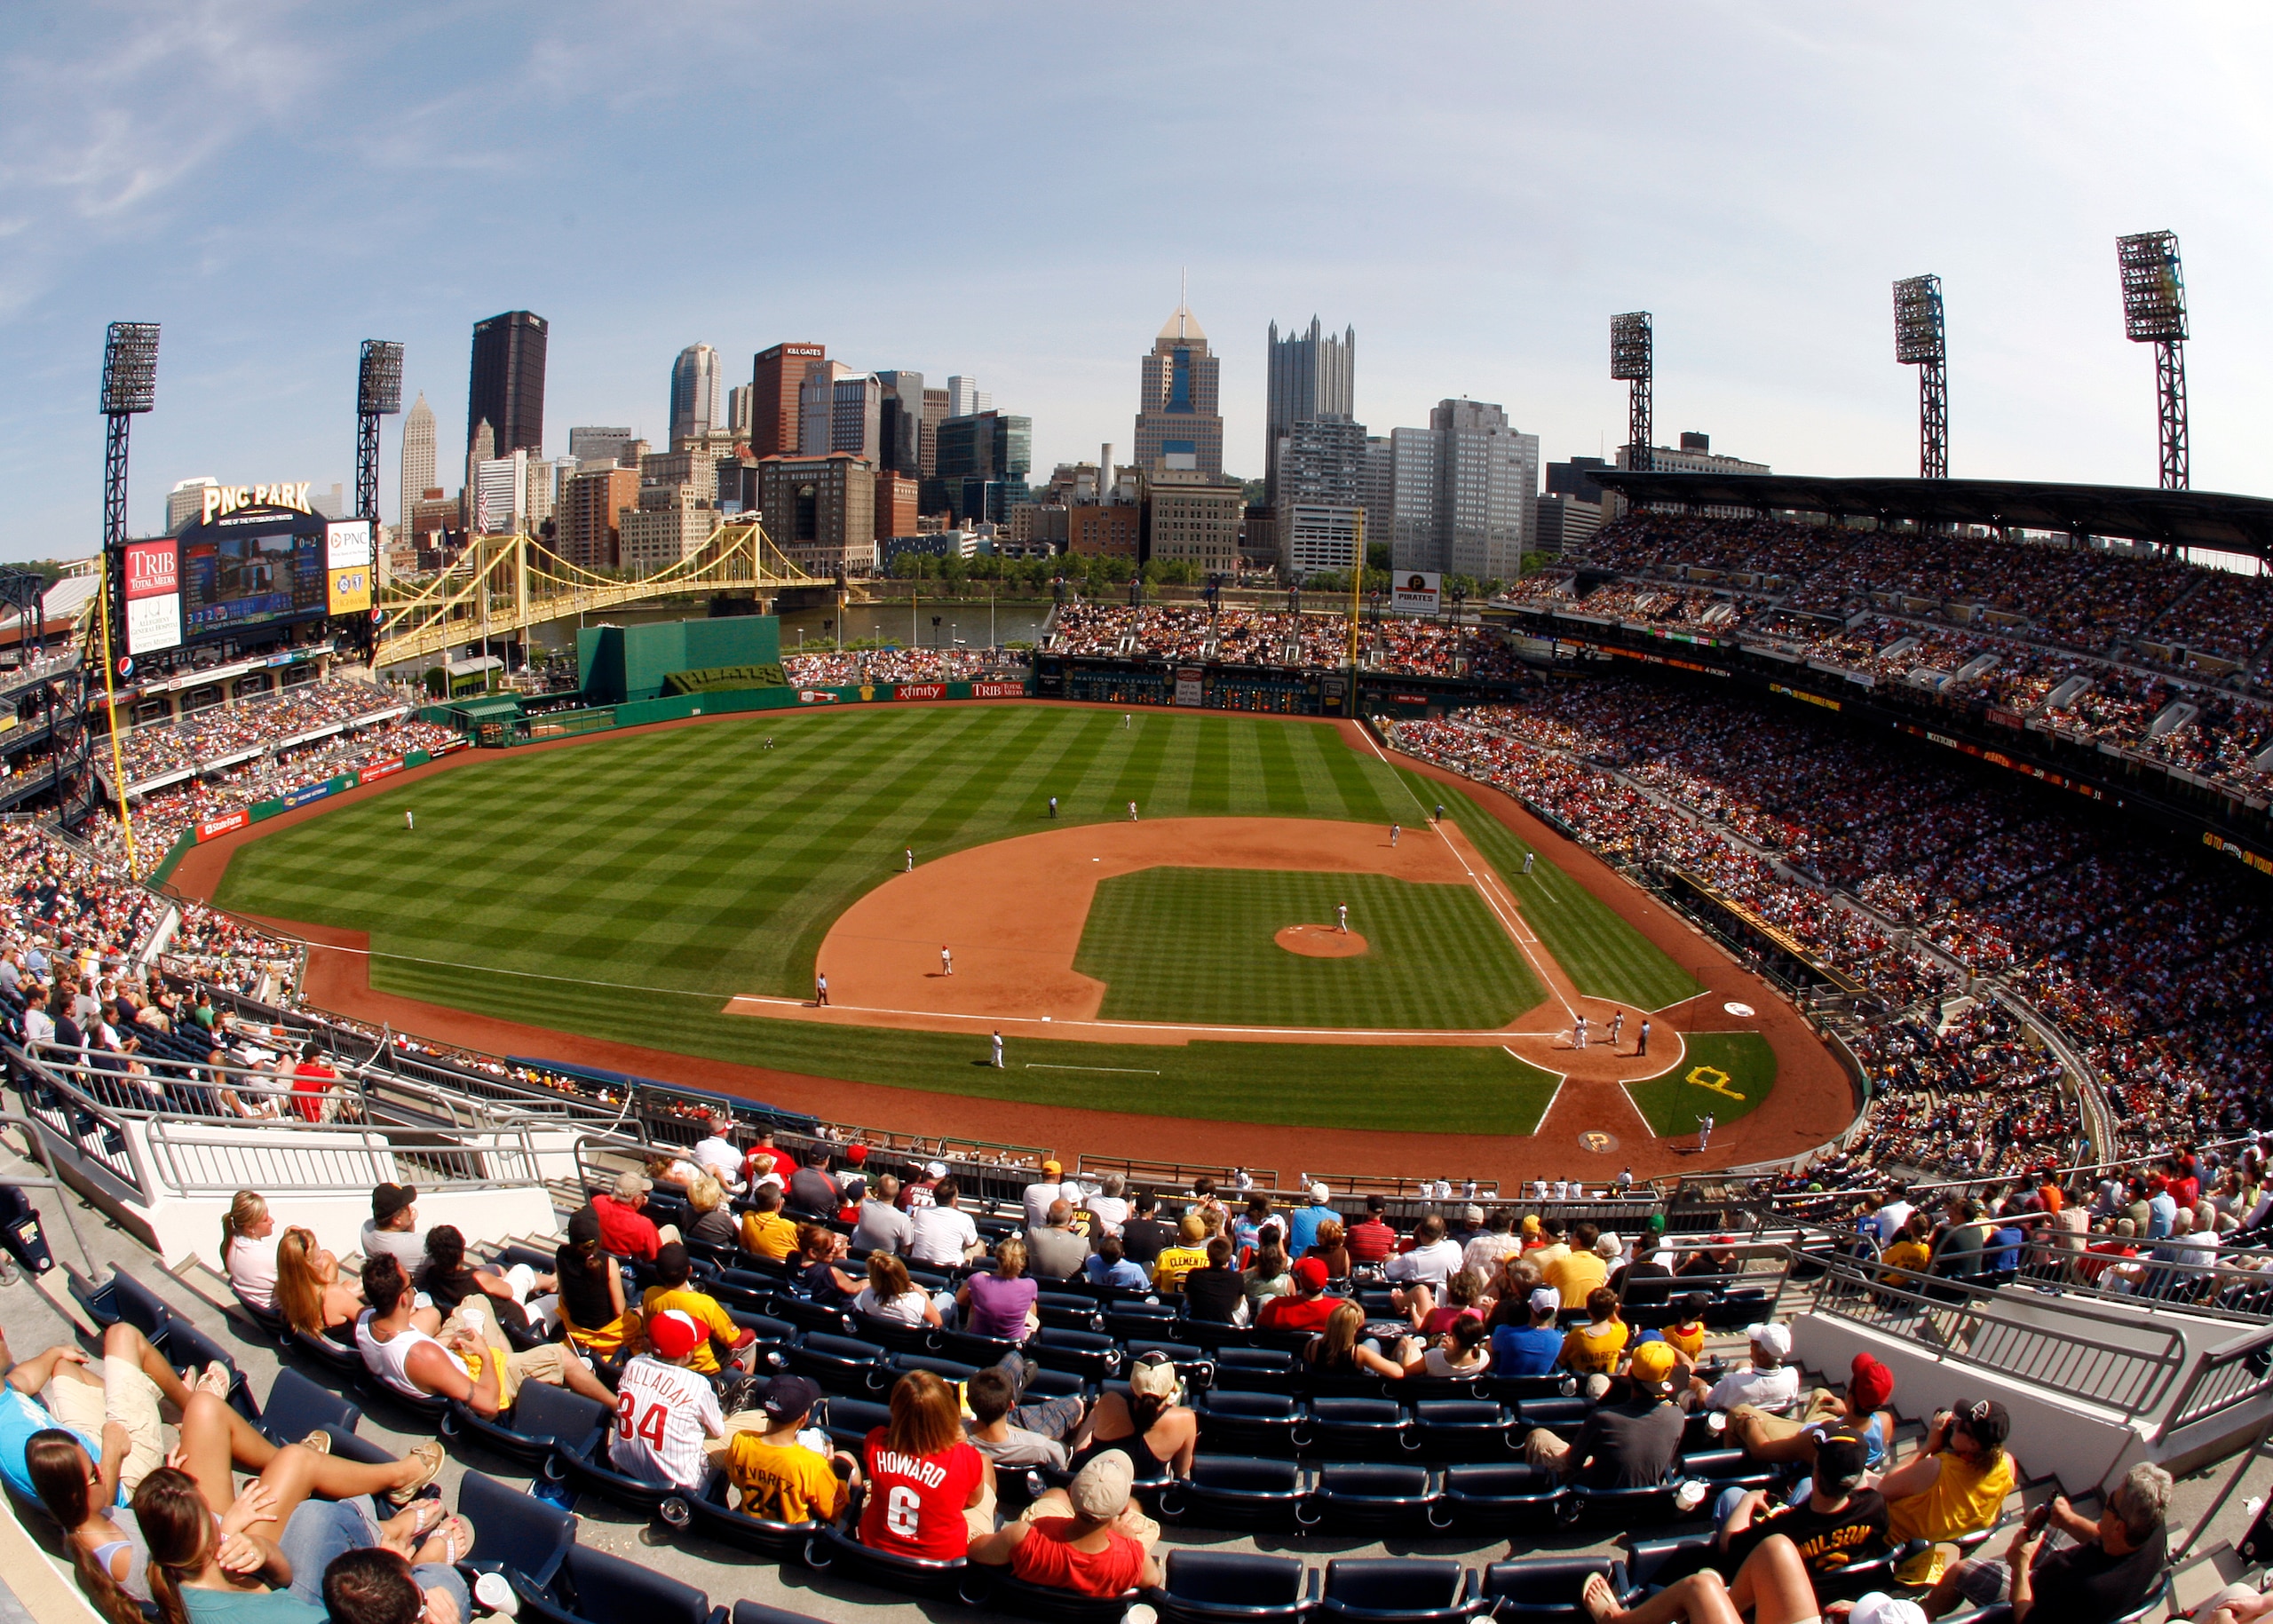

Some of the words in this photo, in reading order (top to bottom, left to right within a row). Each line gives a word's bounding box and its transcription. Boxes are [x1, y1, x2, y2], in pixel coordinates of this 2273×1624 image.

[202, 486, 250, 526] PNC
[253, 482, 312, 515] PARK
[344, 532, 367, 545] PNC
[130, 551, 175, 577] TRIB
[131, 577, 153, 590] TOTAL
[154, 575, 176, 586] MEDIA
[1398, 593, 1433, 602] PIRATES
[131, 625, 154, 636] GENERAL
[155, 622, 178, 631] HOSPITAL
[139, 615, 170, 627] ALLEGHENY
[134, 640, 153, 650] SPORTS
[154, 636, 178, 646] MEDICINE
[672, 666, 783, 692] PIRATES
[1125, 677, 1162, 686] LEAGUE
[899, 684, 940, 700] xfinity
[972, 683, 1002, 696] TRIB
[1269, 686, 1308, 695] LEAGUE
[1986, 709, 2006, 725] TRIB
[1984, 751, 2009, 768] PIRATES
[2064, 779, 2070, 788] 9
[2093, 789, 2102, 800] 31
[2203, 831, 2214, 846] GO
[2213, 835, 2222, 851] TO
[2242, 850, 2254, 867] ON
[2253, 855, 2273, 876] YOUR
[1684, 1066, 1746, 1101] P
[910, 1186, 934, 1197] PHILL
[1580, 1351, 1617, 1364] ALVAREZ
[618, 1390, 669, 1452] 34
[876, 1451, 946, 1489] HOWARD
[735, 1464, 795, 1493] ALVAREZ
[887, 1485, 921, 1535] 6
[1798, 1525, 1873, 1559] WILSON
